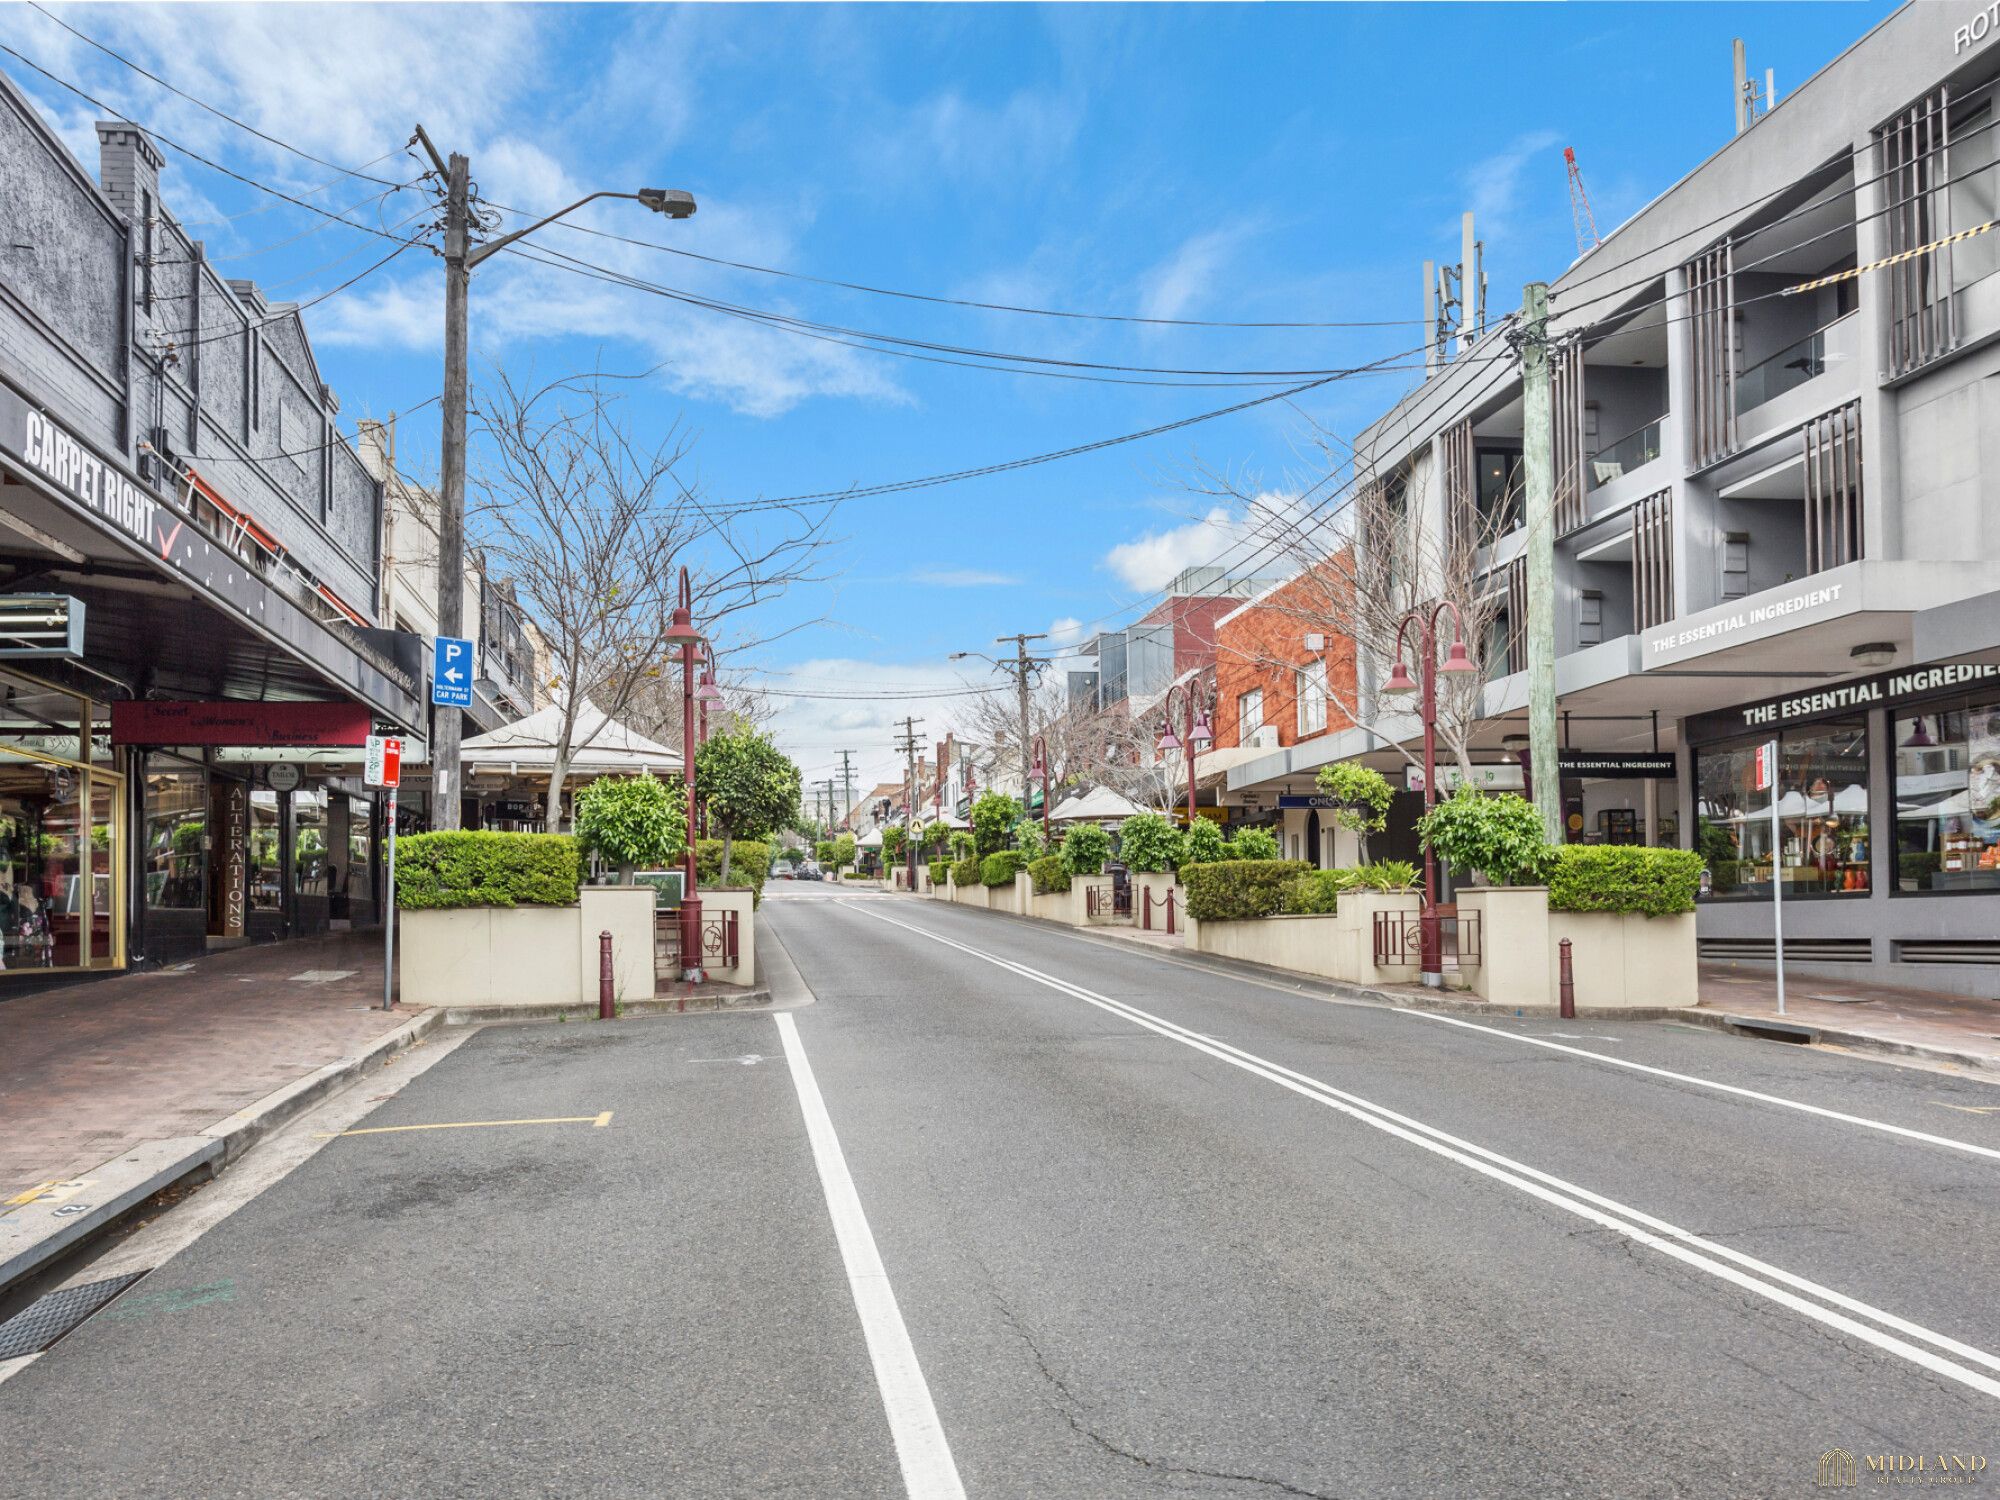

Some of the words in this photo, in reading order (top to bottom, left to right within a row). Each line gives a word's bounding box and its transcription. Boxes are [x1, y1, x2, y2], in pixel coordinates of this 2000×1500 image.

[24, 410, 102, 508] CARPET
[104, 468, 155, 544] RIGHT
[1652, 636, 1676, 653] THE
[1679, 614, 1746, 646] ESSENTIAL
[1750, 584, 1842, 624] INGREDIENT
[446, 644, 461, 662] P
[437, 691, 449, 699] CAR
[451, 692, 468, 701] PARK
[1743, 704, 1777, 726] THE
[1781, 682, 1883, 718] ESSENTIAL
[1889, 664, 2000, 696] INGREDIE
[229, 787, 243, 928] ALTERATIONS
